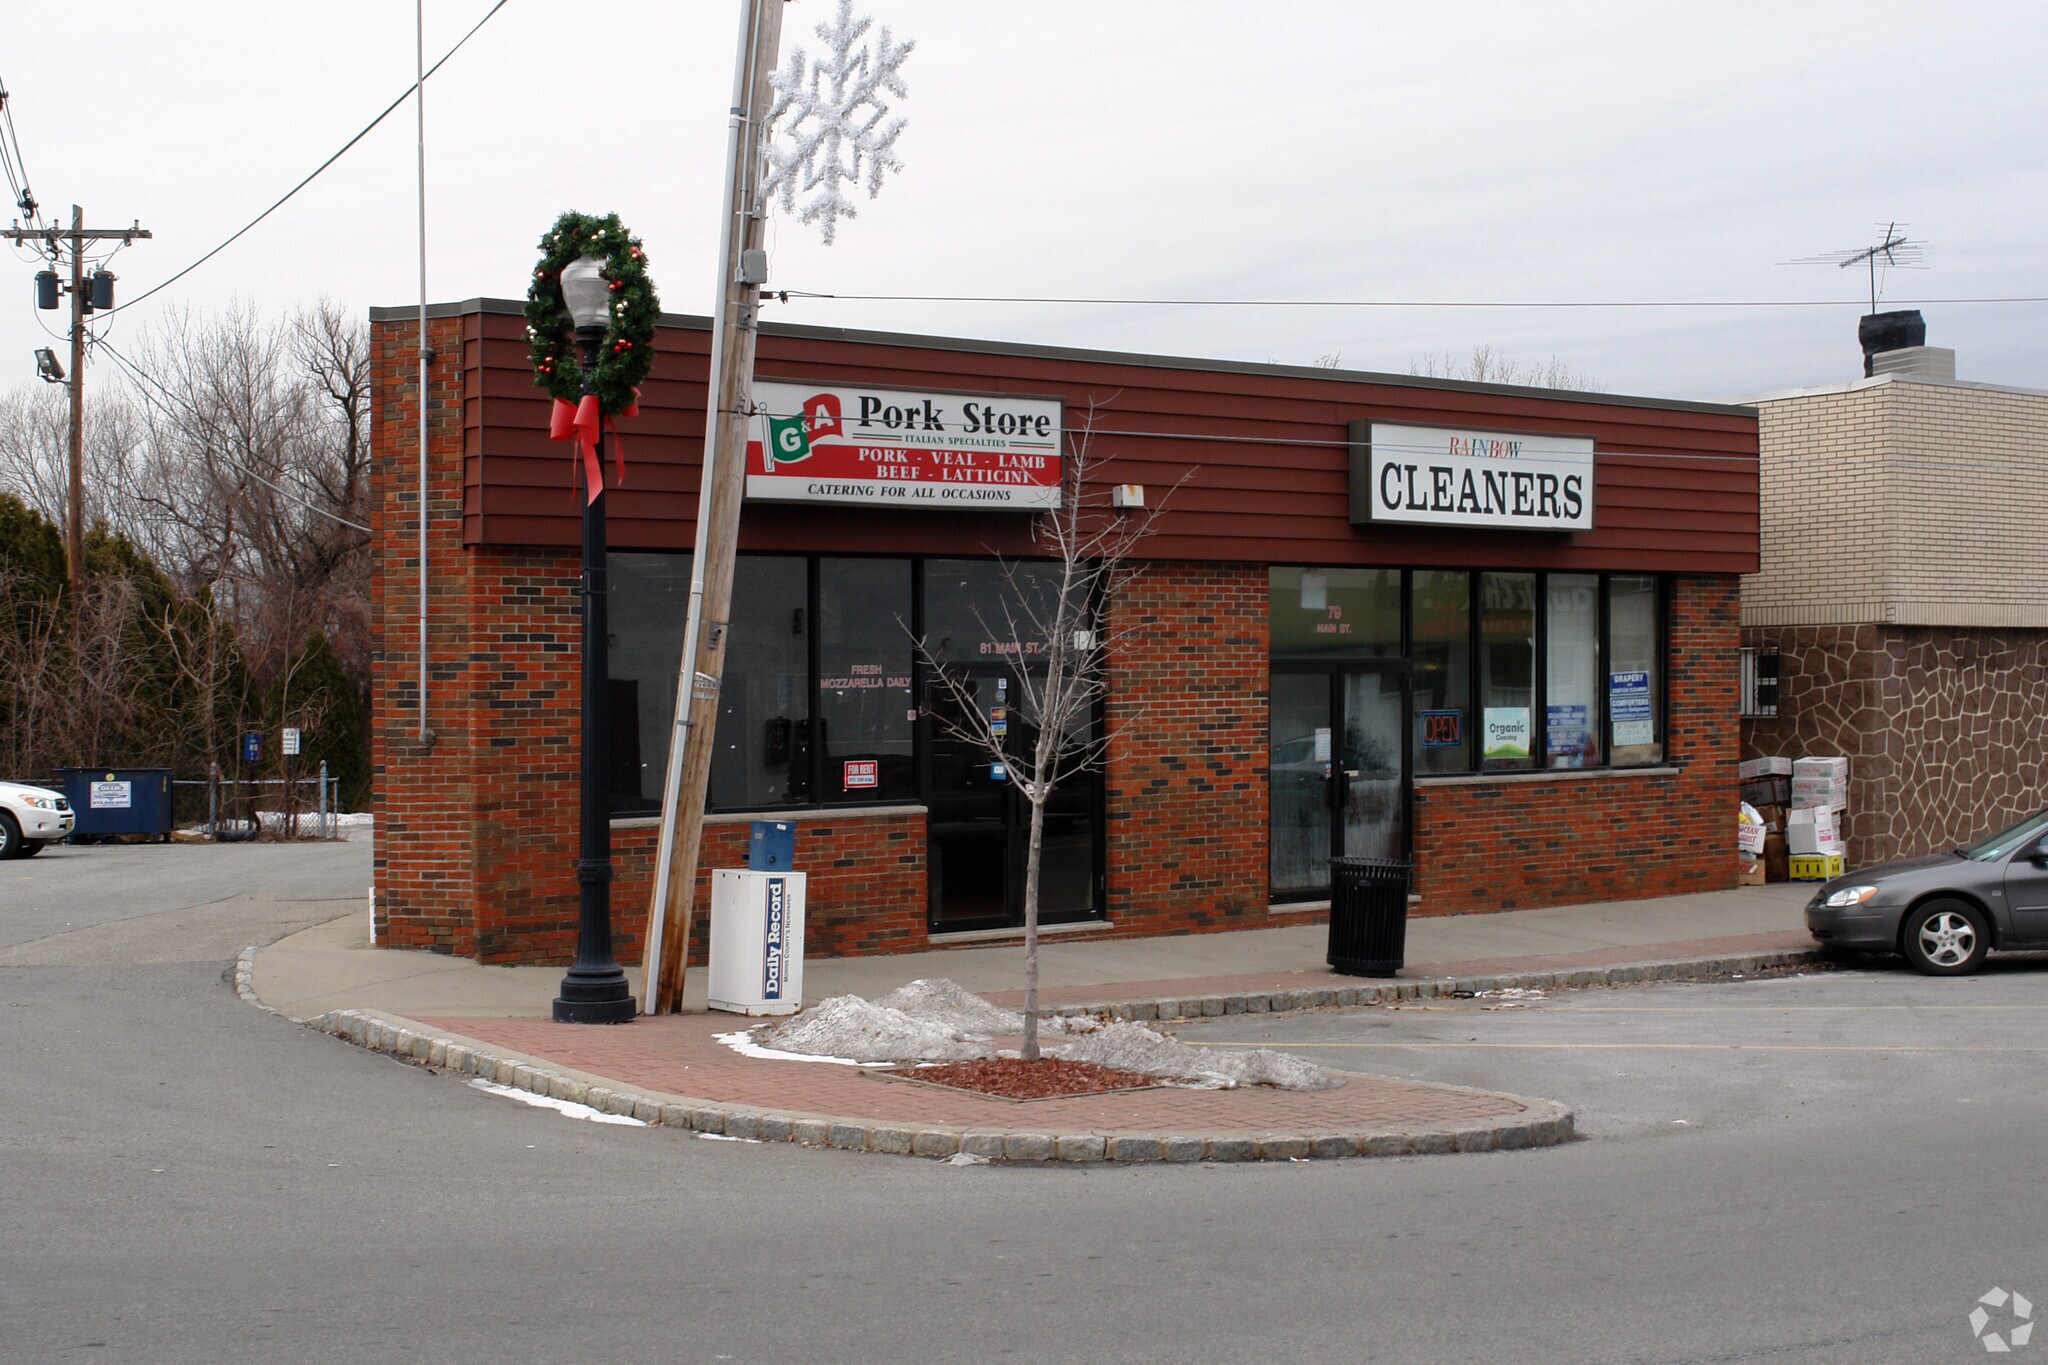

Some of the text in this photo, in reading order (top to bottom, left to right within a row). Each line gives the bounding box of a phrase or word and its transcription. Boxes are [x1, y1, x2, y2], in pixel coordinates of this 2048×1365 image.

[858, 395, 1051, 437] Pork Store
[780, 404, 835, 452] G&A
[905, 434, 1007, 448] ITALIAN SPECIALTIES
[1449, 436, 1523, 459] RAINBOW
[858, 448, 908, 463] PORK
[931, 451, 977, 466] VEAL
[998, 454, 1046, 469] LAMB
[876, 464, 920, 480] BEEF
[942, 468, 1031, 484] LATTICINI
[808, 483, 1012, 501] CATERING FOR ALL OCCASIONS
[1380, 461, 1583, 519] CLEANERS
[1327, 605, 1342, 619] 79
[1316, 623, 1337, 633] MAIN
[979, 642, 992, 654] 81
[995, 642, 1021, 654] MAIN
[851, 664, 882, 675] FRESH
[820, 677, 911, 689] MOZZARELLA DAILY
[1614, 674, 1644, 683] DRAPERY
[1425, 716, 1459, 742] OPEN
[1489, 721, 1524, 735] Organic
[848, 763, 874, 775] FOR RENT
[765, 883, 782, 993] Daily Record
